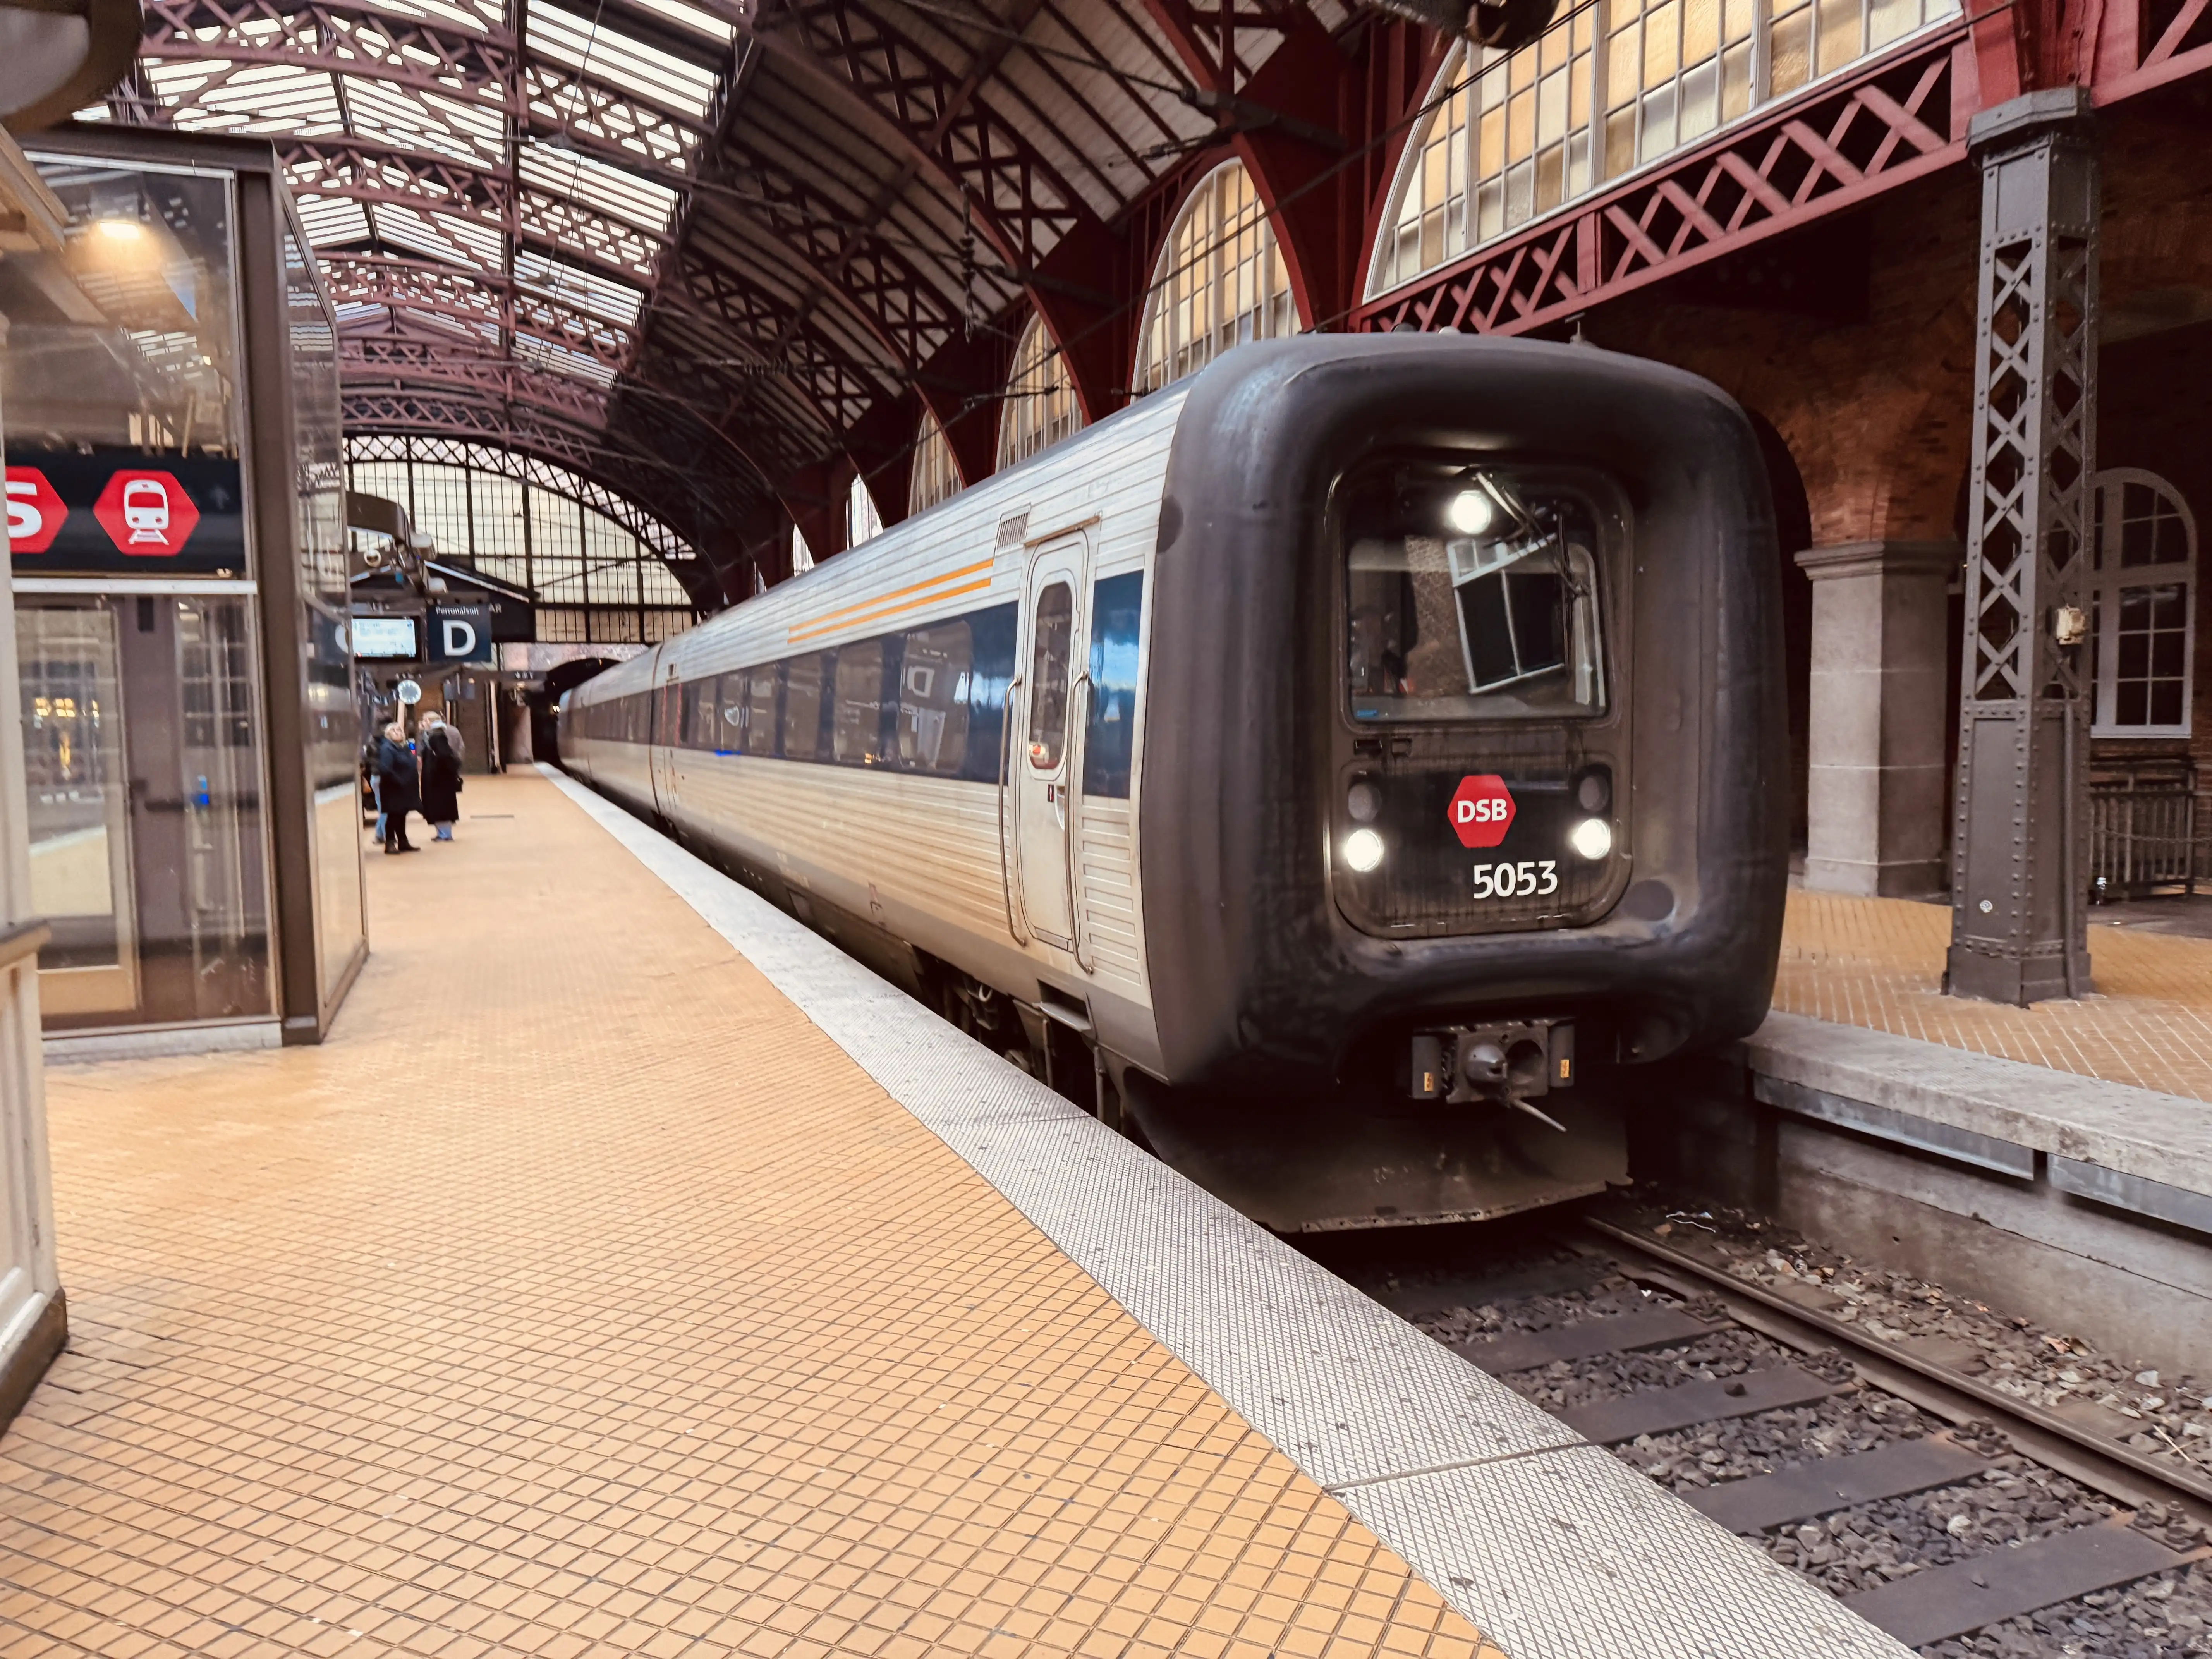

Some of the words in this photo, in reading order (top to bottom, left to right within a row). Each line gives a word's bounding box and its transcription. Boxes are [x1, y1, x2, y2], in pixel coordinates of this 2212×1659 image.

[443, 620, 476, 656] D
[1457, 799, 1507, 823] DSB
[1474, 860, 1558, 899] 5053
